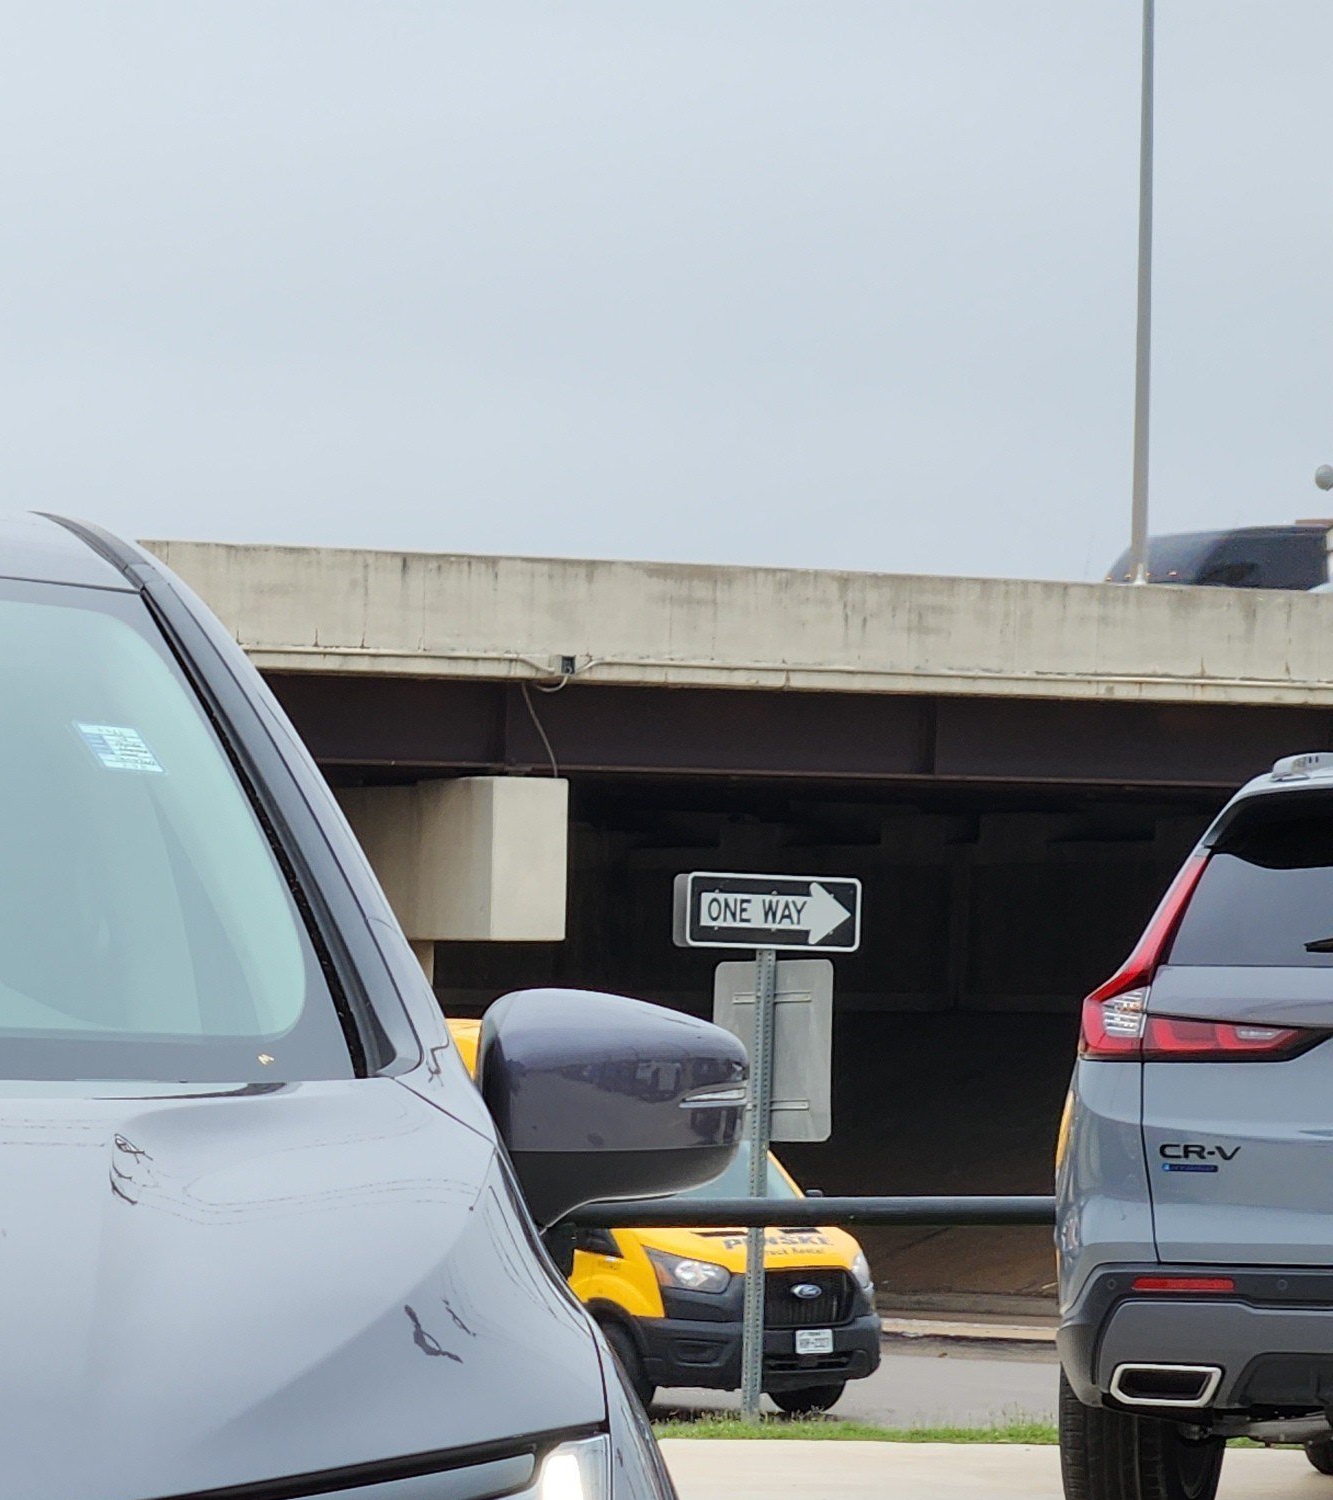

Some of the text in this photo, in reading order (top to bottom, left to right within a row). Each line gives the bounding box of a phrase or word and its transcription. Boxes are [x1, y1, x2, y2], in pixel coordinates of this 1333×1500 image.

[707, 896, 808, 926] ONE WAY
[1159, 1143, 1241, 1161] CR-V
